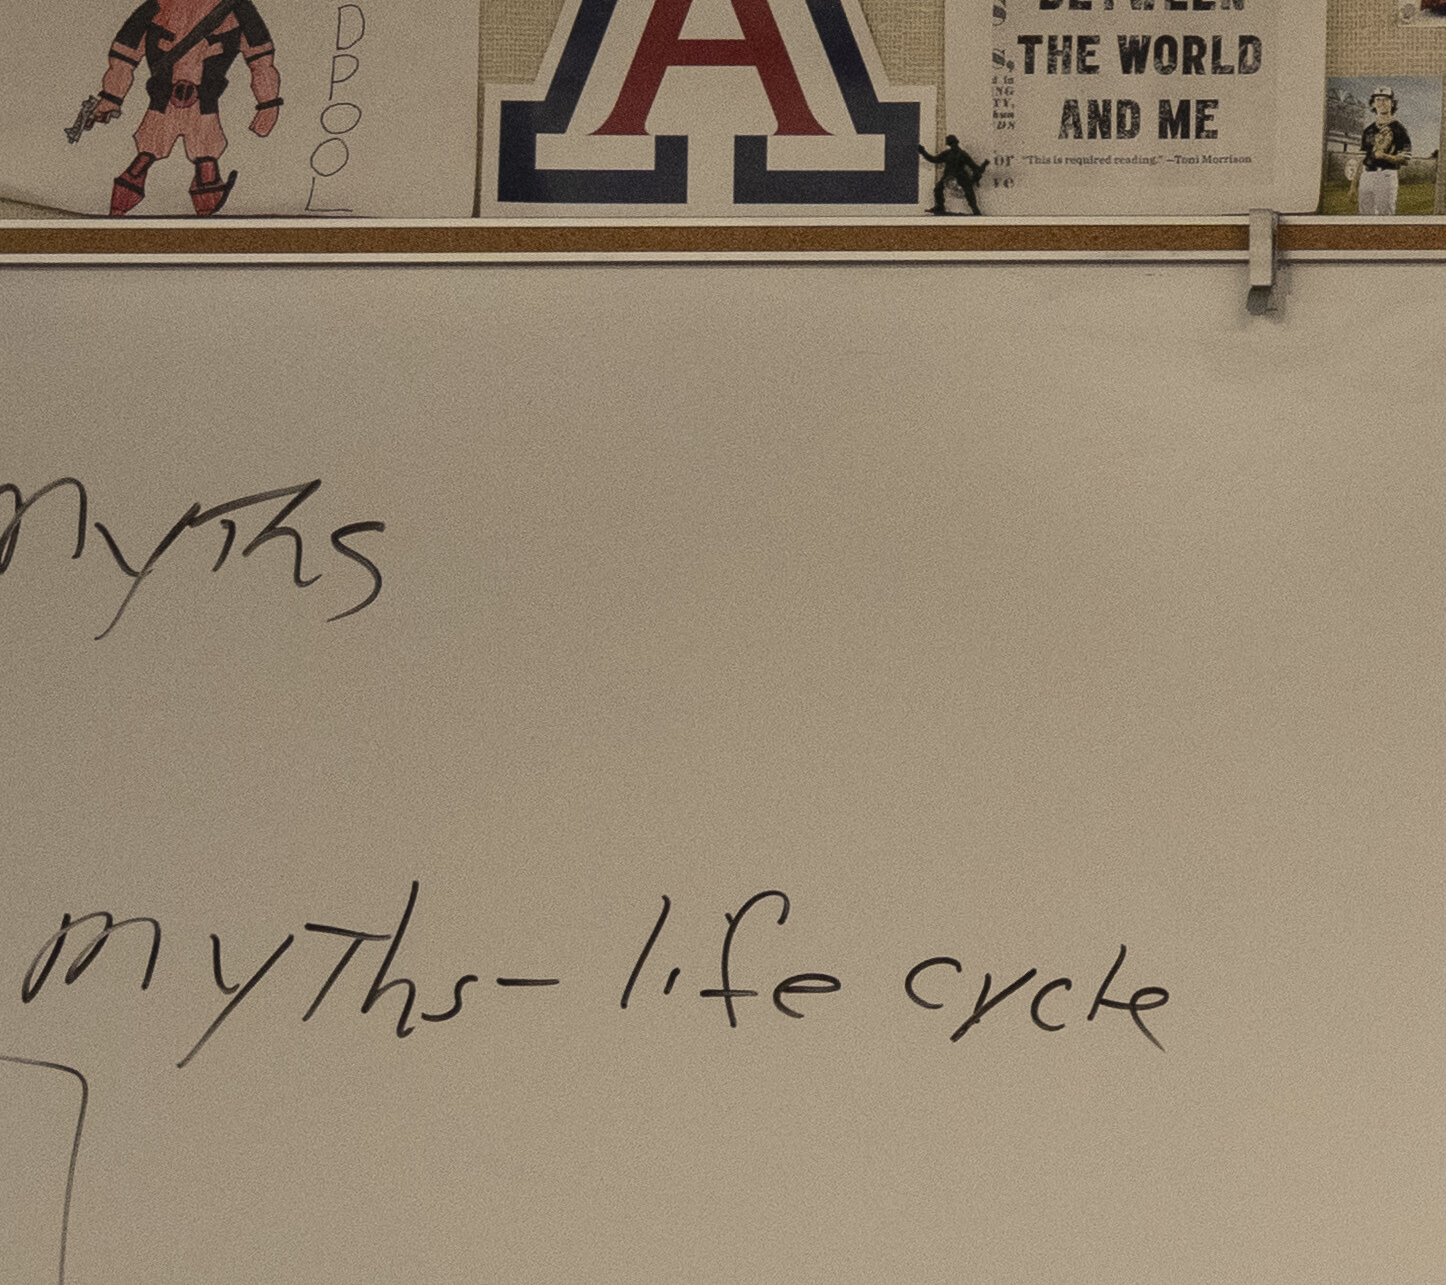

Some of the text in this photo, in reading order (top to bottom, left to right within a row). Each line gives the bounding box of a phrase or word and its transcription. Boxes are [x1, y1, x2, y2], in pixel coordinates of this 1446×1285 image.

[1017, 35, 1263, 75] THE WORLD
[1058, 99, 1141, 140] AND
[1157, 99, 1219, 140] ME
[621, 889, 842, 1028] life
[903, 943, 1172, 1053] cycle
